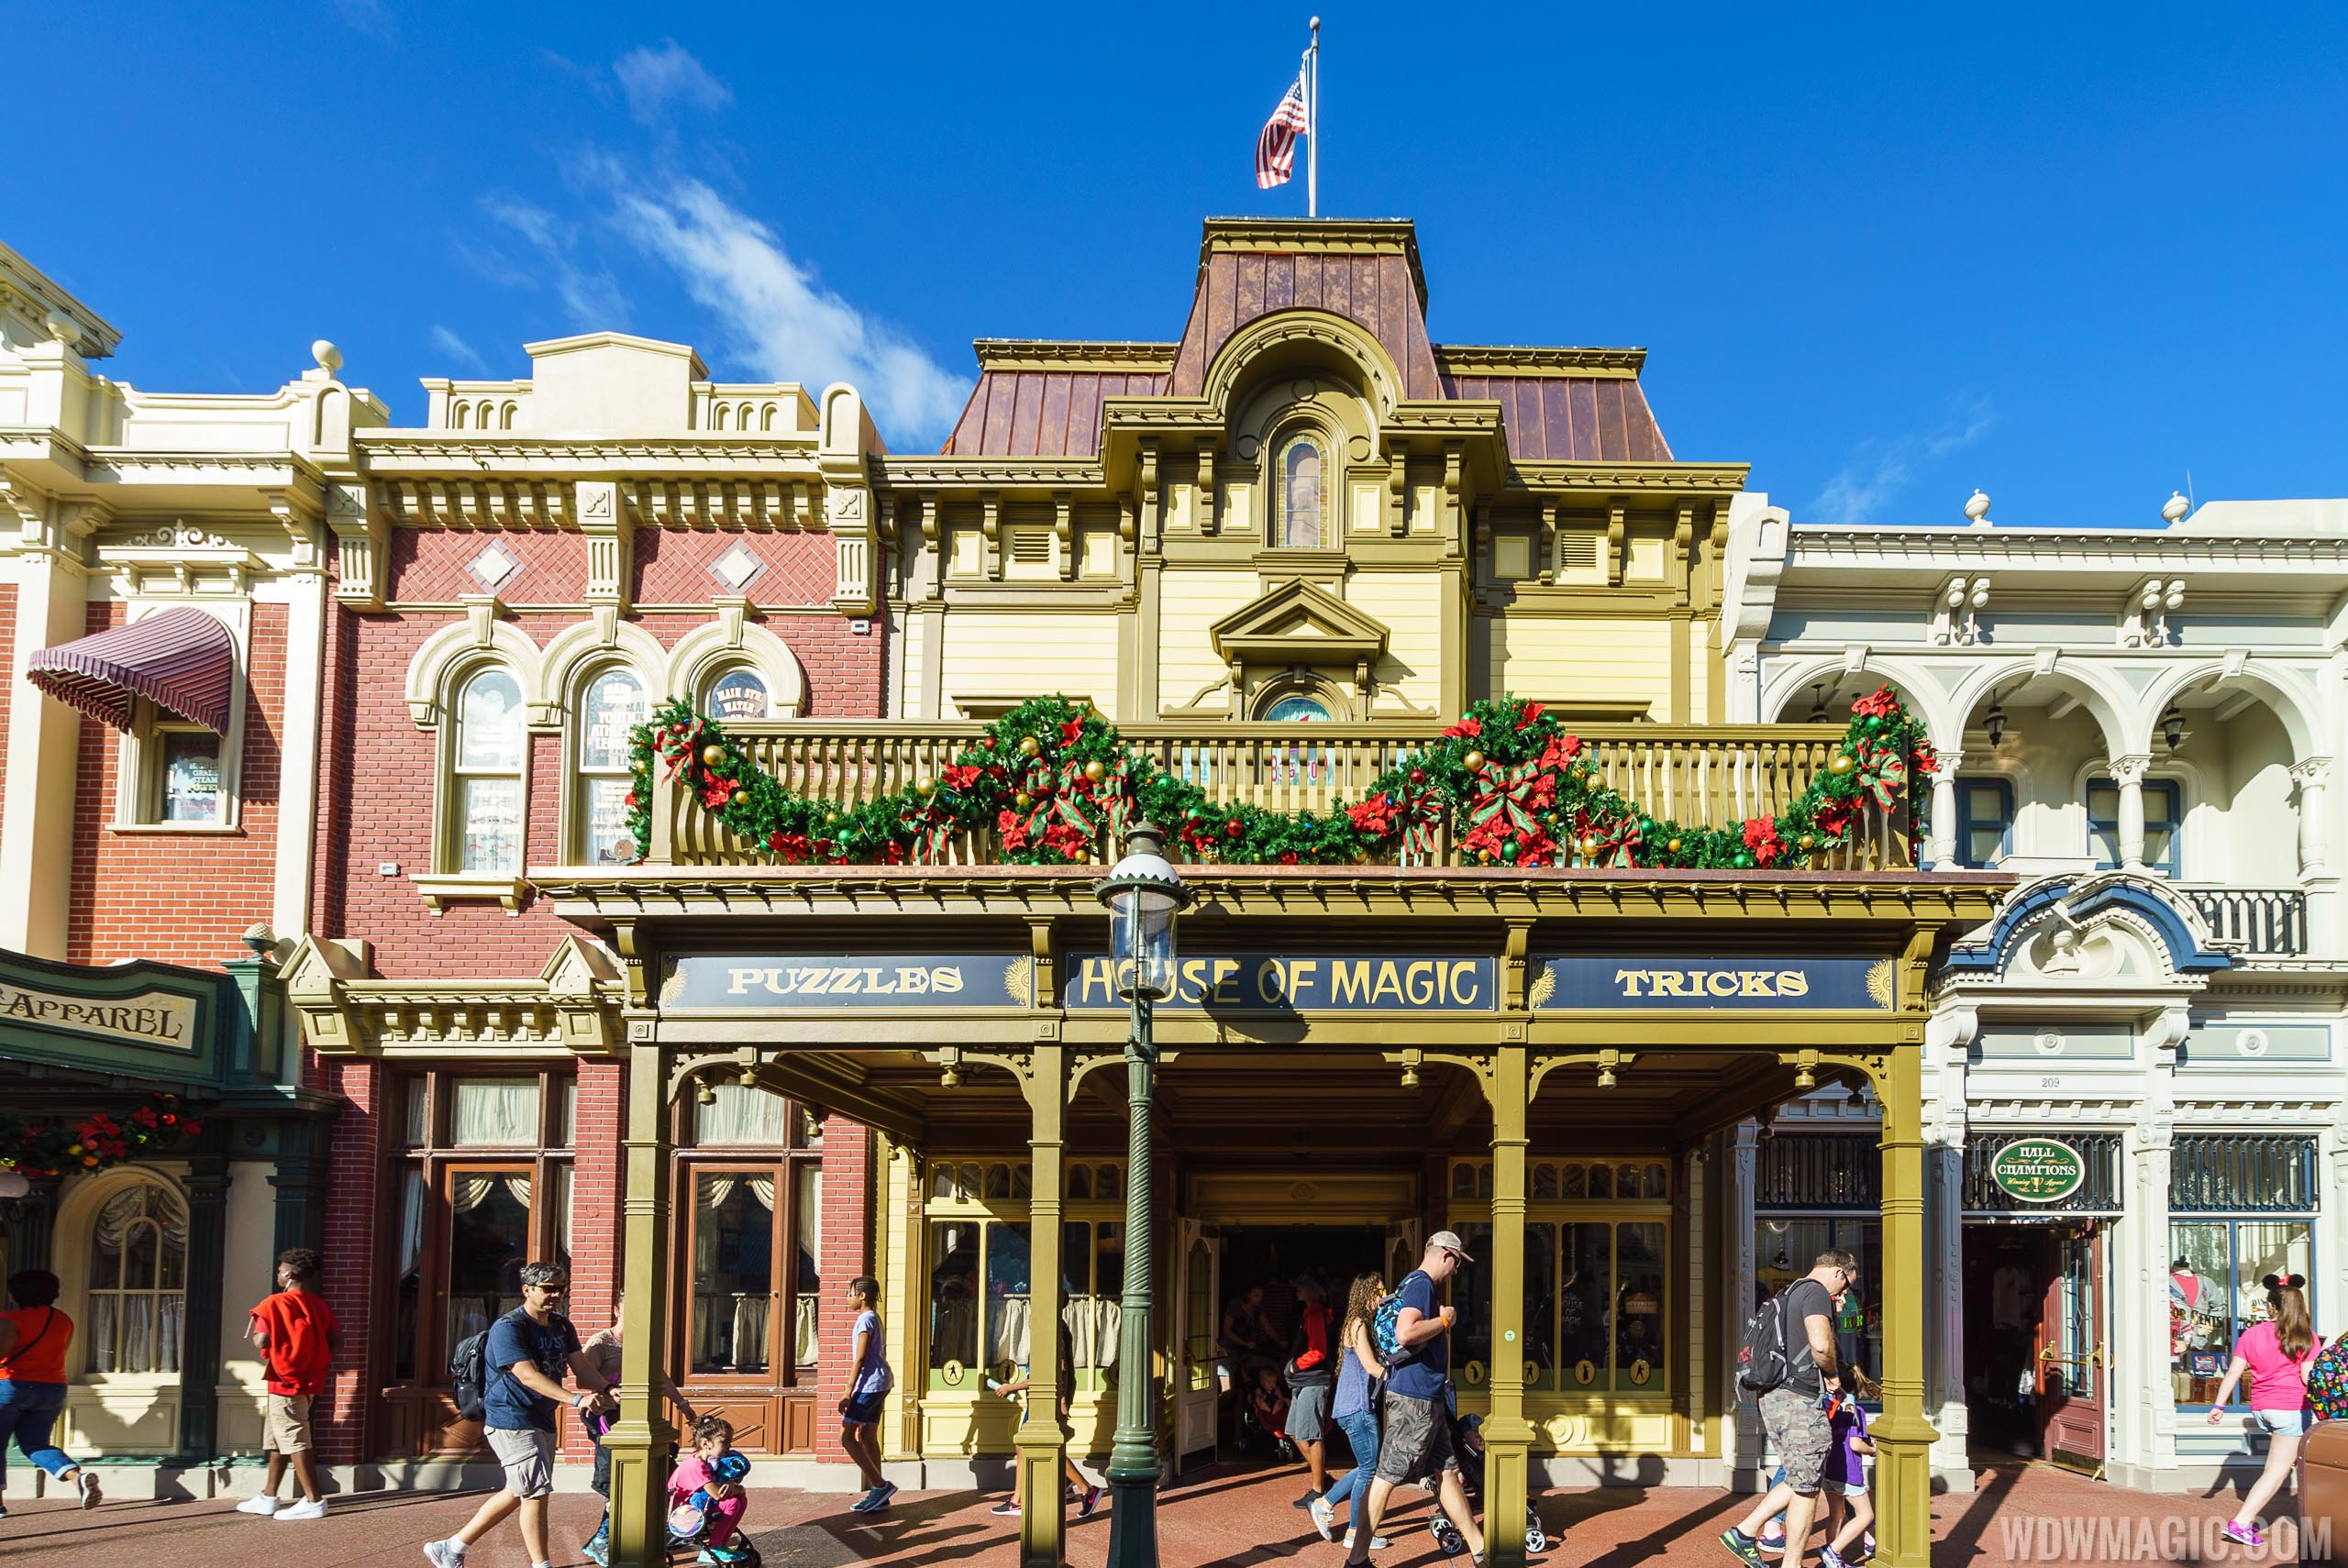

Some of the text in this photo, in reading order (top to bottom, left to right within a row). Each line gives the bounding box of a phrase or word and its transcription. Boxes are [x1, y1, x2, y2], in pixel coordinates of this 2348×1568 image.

[727, 966, 963, 994] PUZZLES
[1081, 958, 1479, 1005] HOUSE OF MAGIC
[1615, 969, 1809, 997] TRICKS
[3, 991, 183, 1041] APPAREL
[2042, 1077, 2060, 1088] 209
[2019, 1147, 2055, 1157] HALL
[1998, 1165, 2077, 1176] CHAMPIONS
